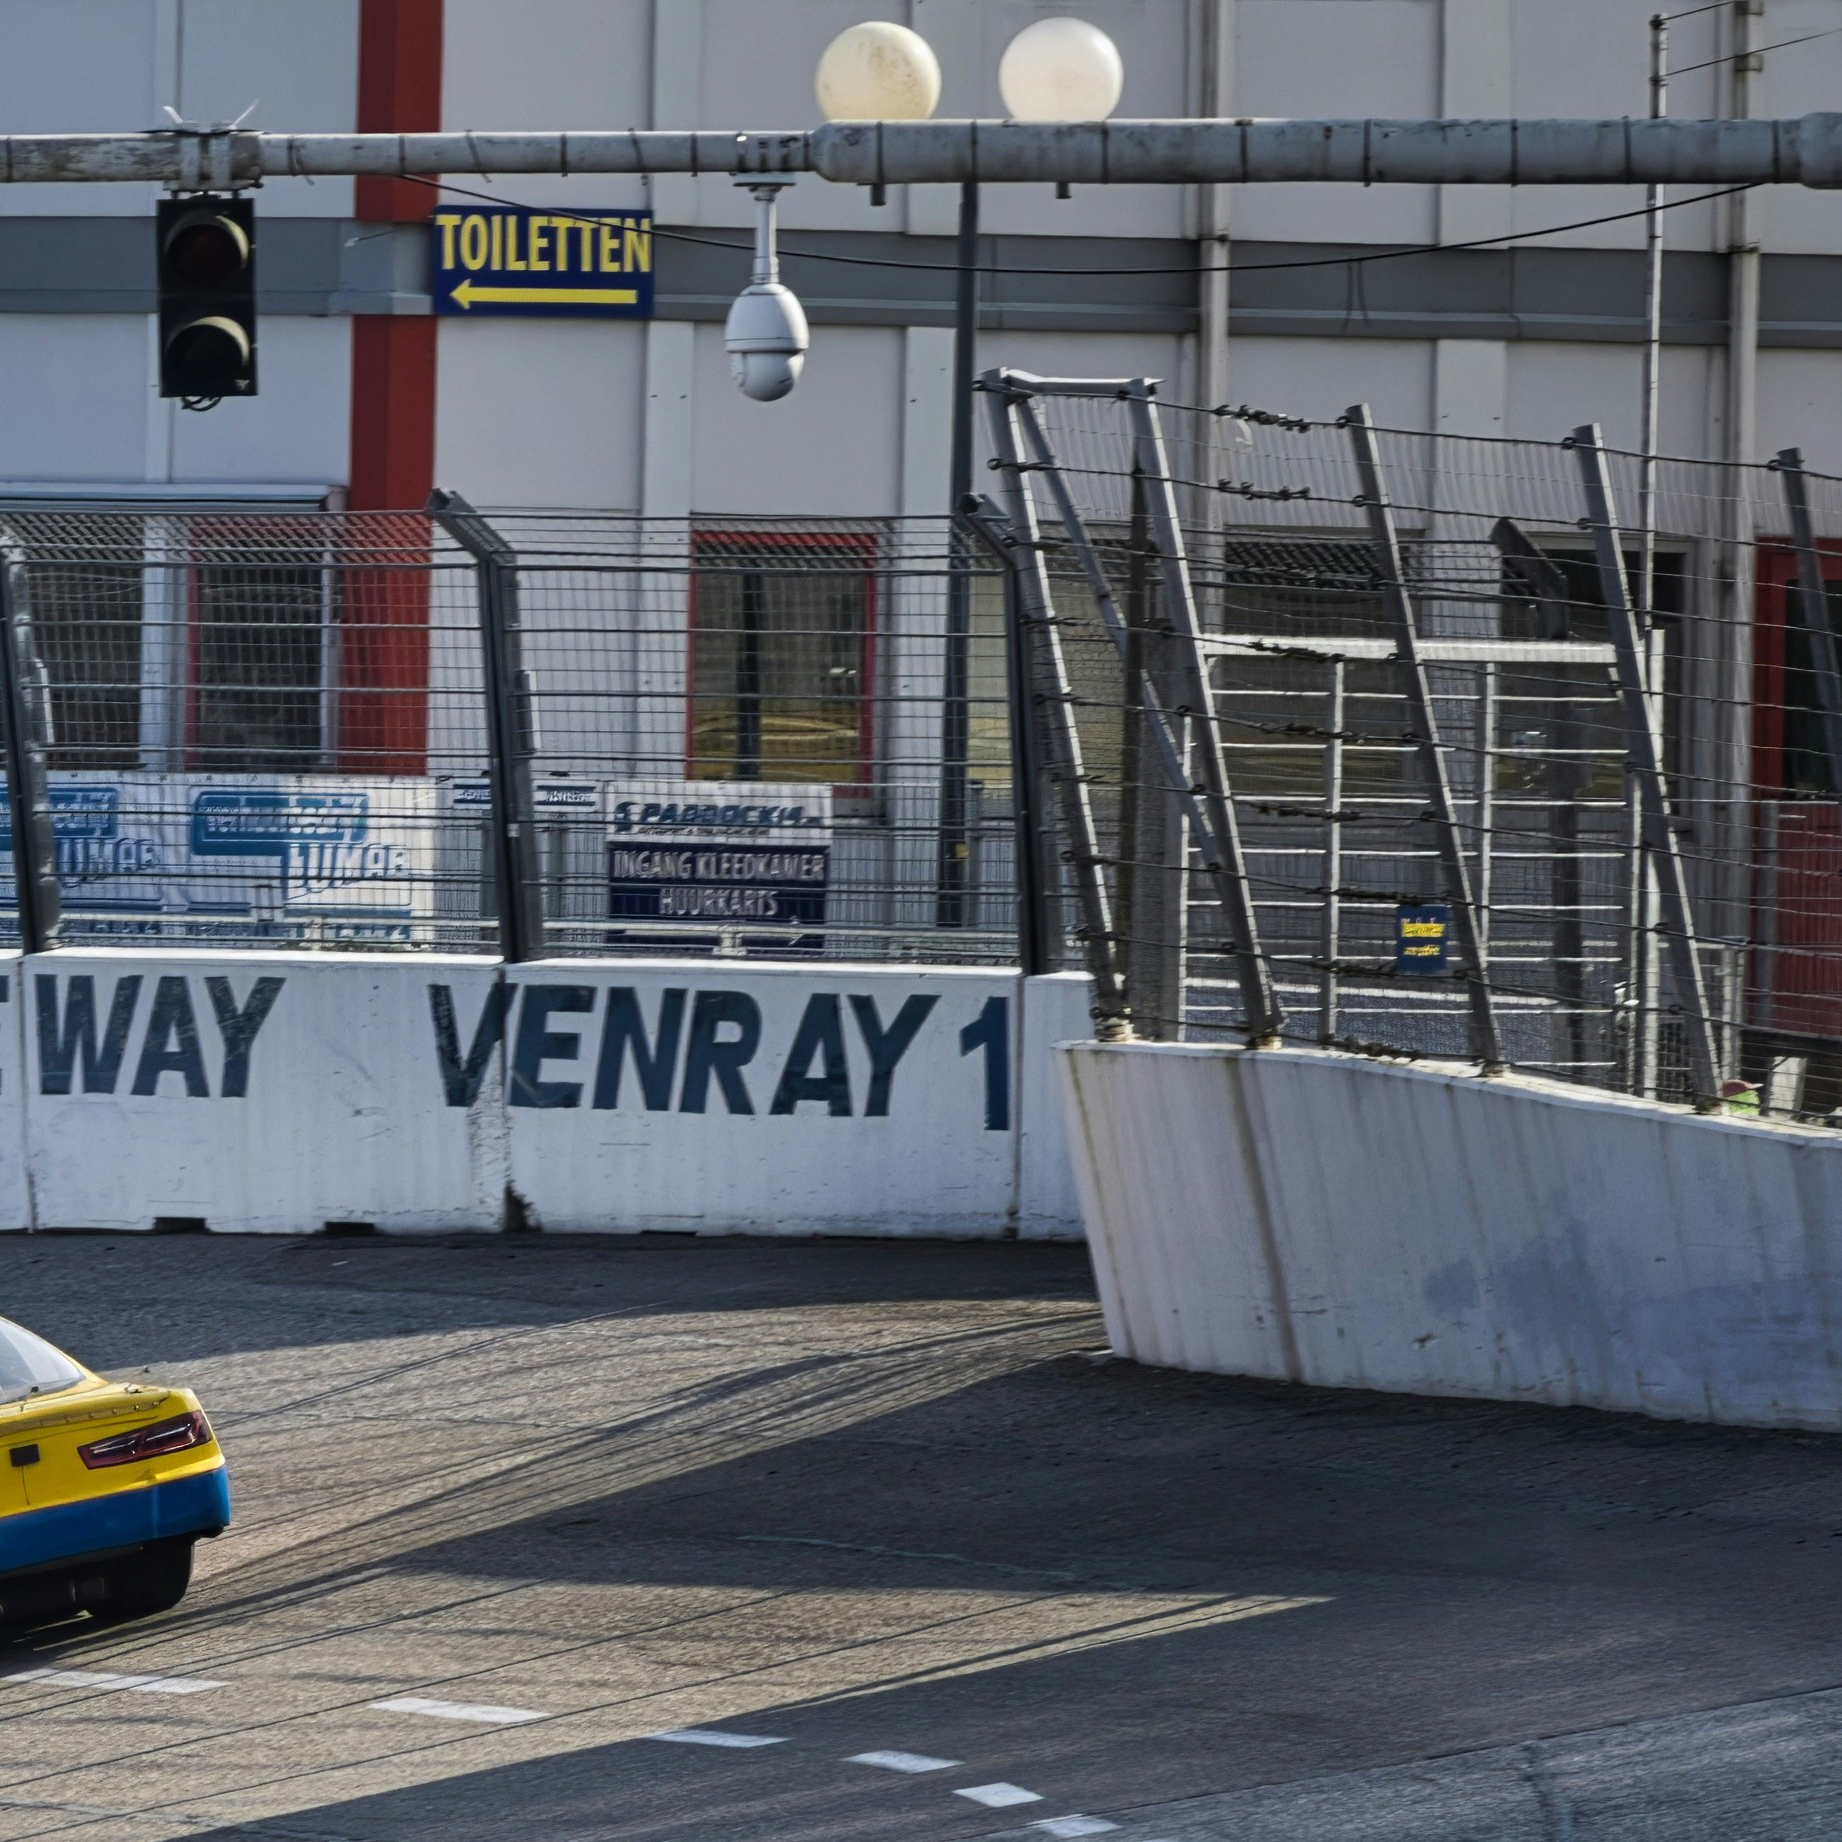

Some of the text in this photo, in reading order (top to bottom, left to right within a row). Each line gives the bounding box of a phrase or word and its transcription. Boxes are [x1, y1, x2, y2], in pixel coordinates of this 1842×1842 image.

[435, 214, 652, 273] TOILETTEN
[614, 850, 693, 879] INGANG
[427, 983, 942, 1117] VENRAY
[959, 996, 1011, 1131] 1
